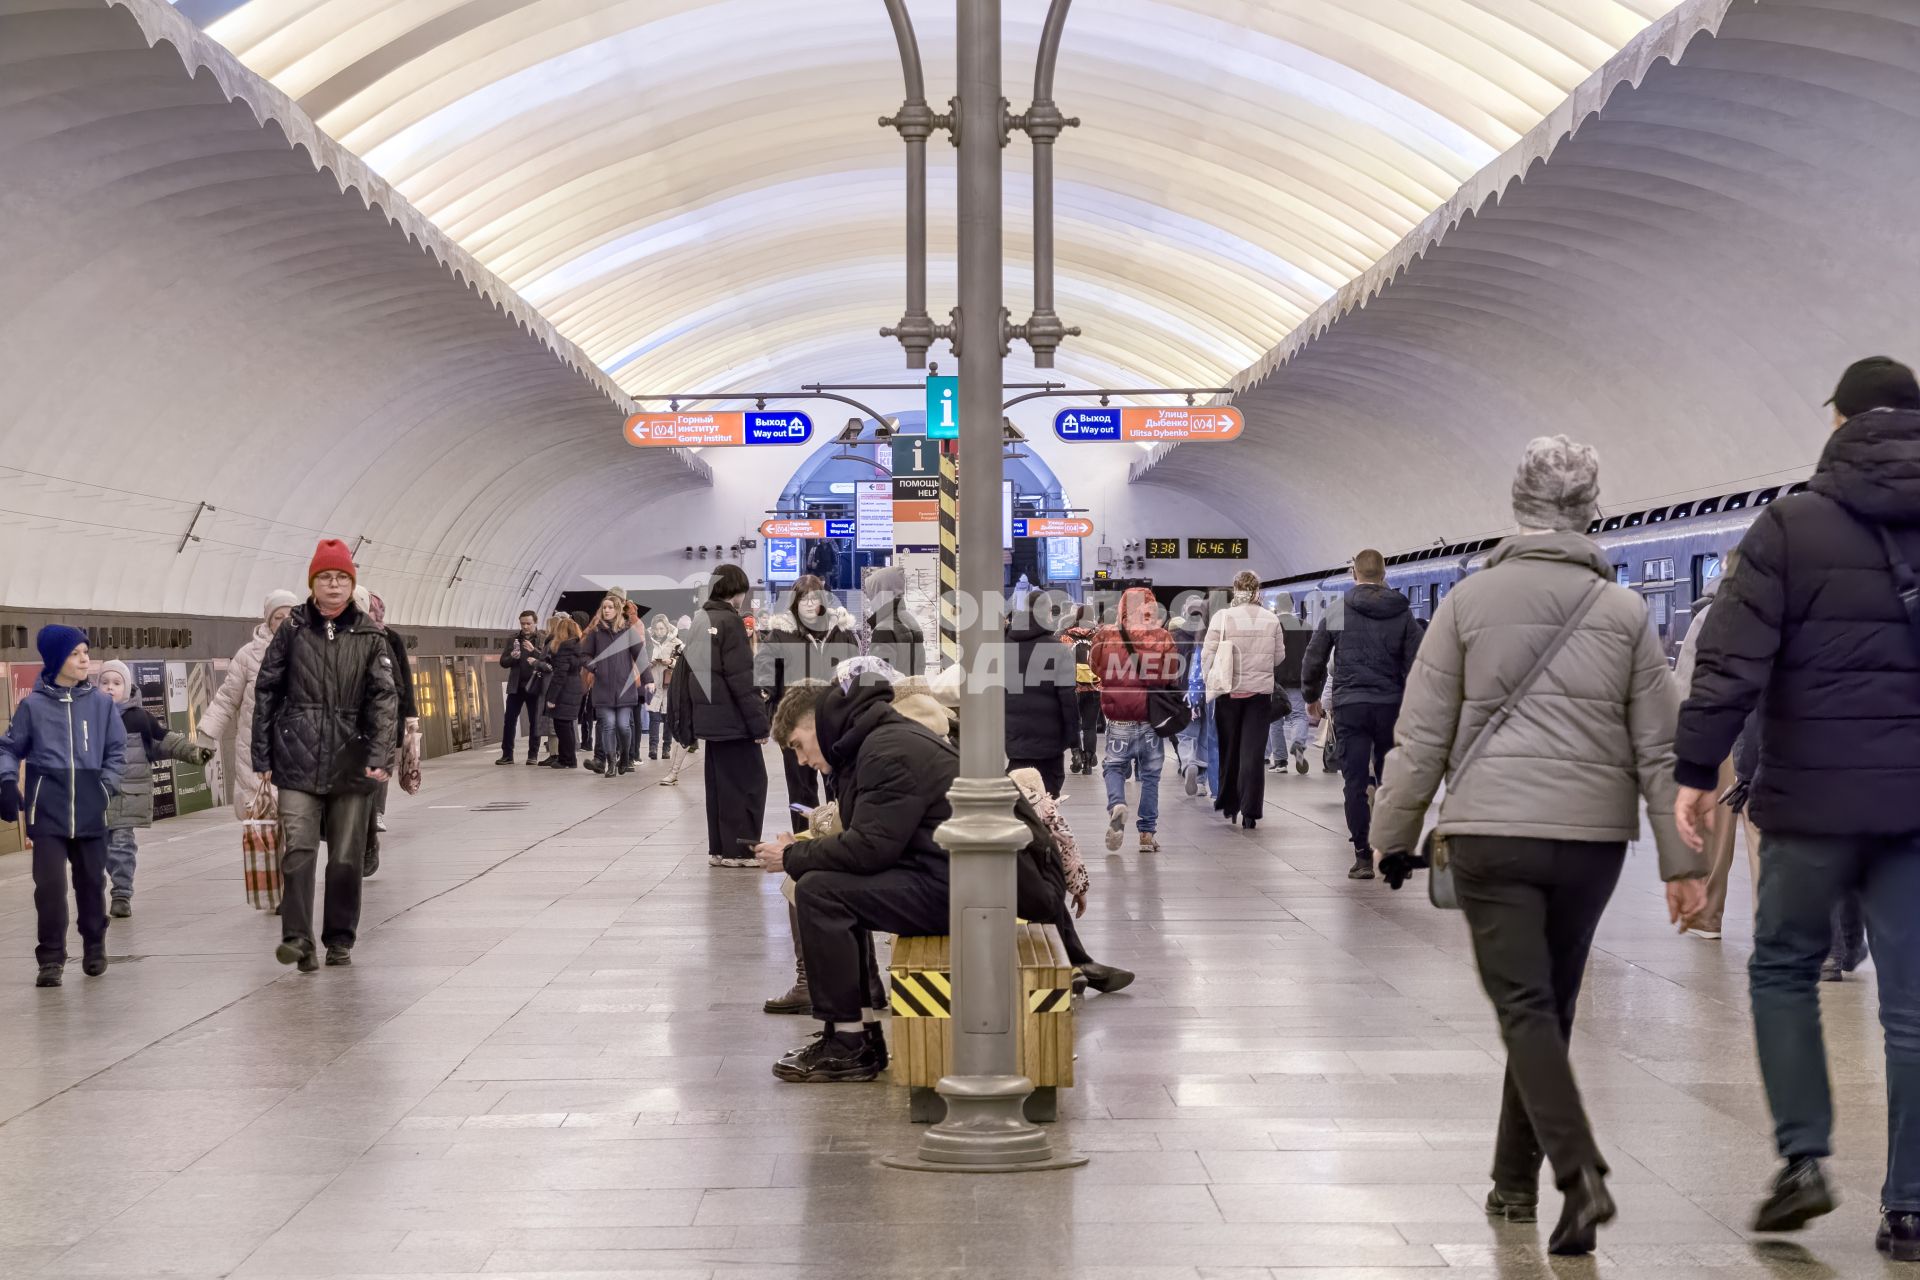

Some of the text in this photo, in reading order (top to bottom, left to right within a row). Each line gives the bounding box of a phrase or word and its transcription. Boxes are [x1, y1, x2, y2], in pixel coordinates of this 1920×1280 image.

[1080, 414, 1111, 424] Выход
[1158, 410, 1189, 418] Улица
[677, 415, 714, 425] Горный
[755, 417, 787, 427] Выход
[1145, 418, 1189, 428] Дыбенко
[677, 425, 720, 434] институт
[752, 429, 787, 439] Way out
[1080, 426, 1114, 436] Way out
[1129, 428, 1189, 439] Ulitsa Dybenko
[678, 434, 733, 443] Gorny Institut
[899, 479, 940, 489] ПОМОЩЬ
[918, 489, 938, 498] HELP
[1149, 542, 1176, 554] 3.38
